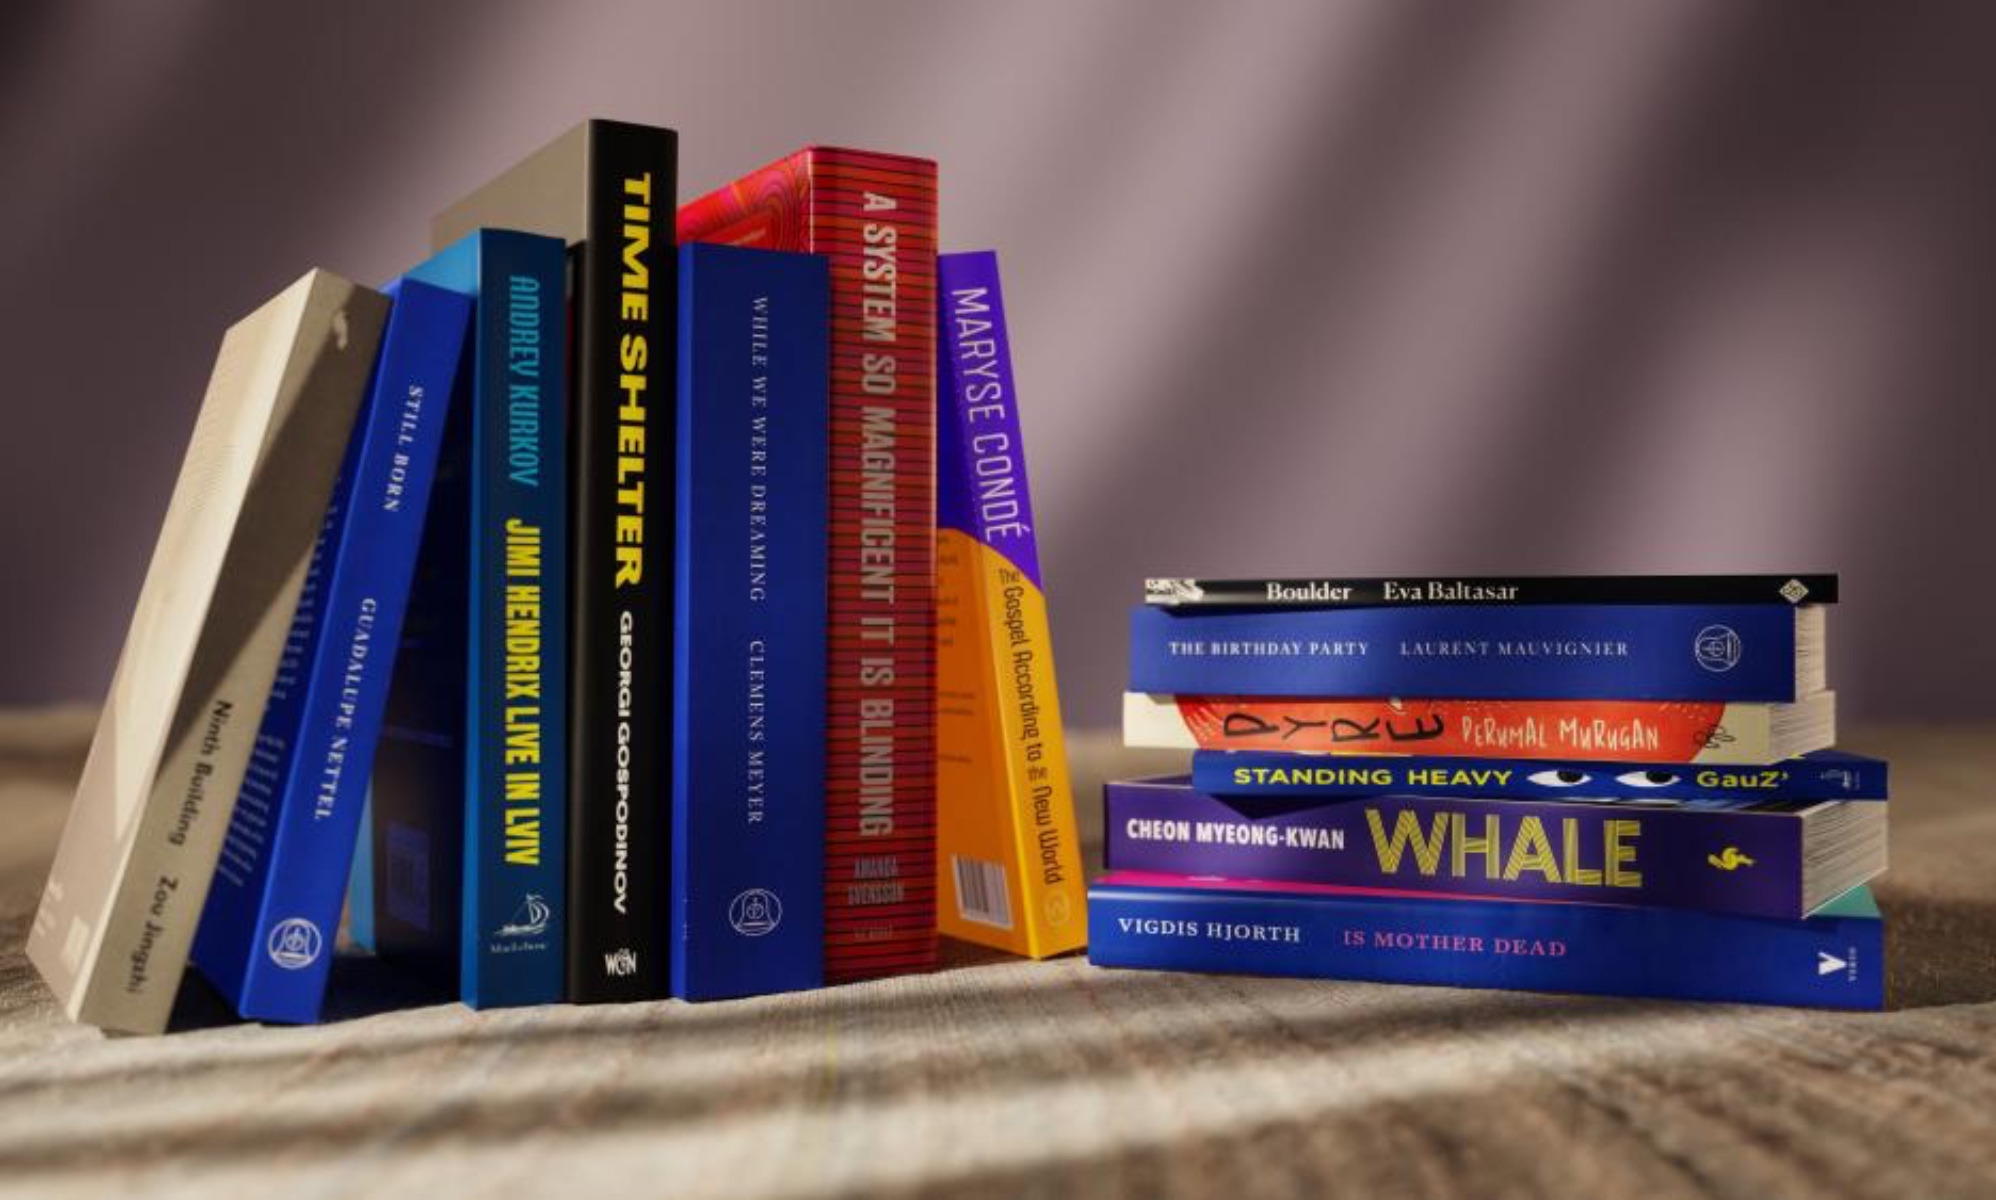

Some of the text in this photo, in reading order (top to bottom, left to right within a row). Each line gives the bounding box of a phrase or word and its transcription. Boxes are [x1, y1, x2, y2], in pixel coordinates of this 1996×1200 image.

[509, 275, 540, 487] ANDREY KURKOV
[615, 173, 652, 589] TIME SHELTER
[952, 287, 1031, 542] MARYSE CONDÉ
[383, 385, 423, 512] STILL BORN
[750, 297, 768, 602] WHILE WE WERE DREAMING
[859, 192, 897, 836] A SYSTEM SO MAGNIFICENT IT IS BLINDING
[1004, 586, 1032, 648] Gospel
[1266, 581, 1519, 600] Boulder Eva Baltasar
[504, 518, 541, 865] JIMI HENDRIX LIVE IN LVIV
[1013, 650, 1040, 741] According
[1168, 641, 1629, 656] THE BIRTHDAY PARTY LAURENT MAUVIGNIER
[314, 598, 376, 820] GUADALUPE NETTEL
[614, 611, 633, 914] GEORGI GOSPODINOV
[747, 641, 765, 823] CLEMENS MEYER
[1027, 743, 1043, 761] to
[1223, 713, 1445, 742] PYRE
[1233, 768, 1393, 785] STANDING
[1408, 769, 1512, 786] HEAVY
[126, 700, 233, 994] Ninth Building Zou Jingzhi
[1040, 829, 1066, 885] World
[1126, 818, 1345, 850] CHEON MYEONG-KWAN
[1364, 808, 1643, 887] WHALE
[1118, 918, 1567, 957] VIGDIS HJORTH IS MOTHER DEAD
